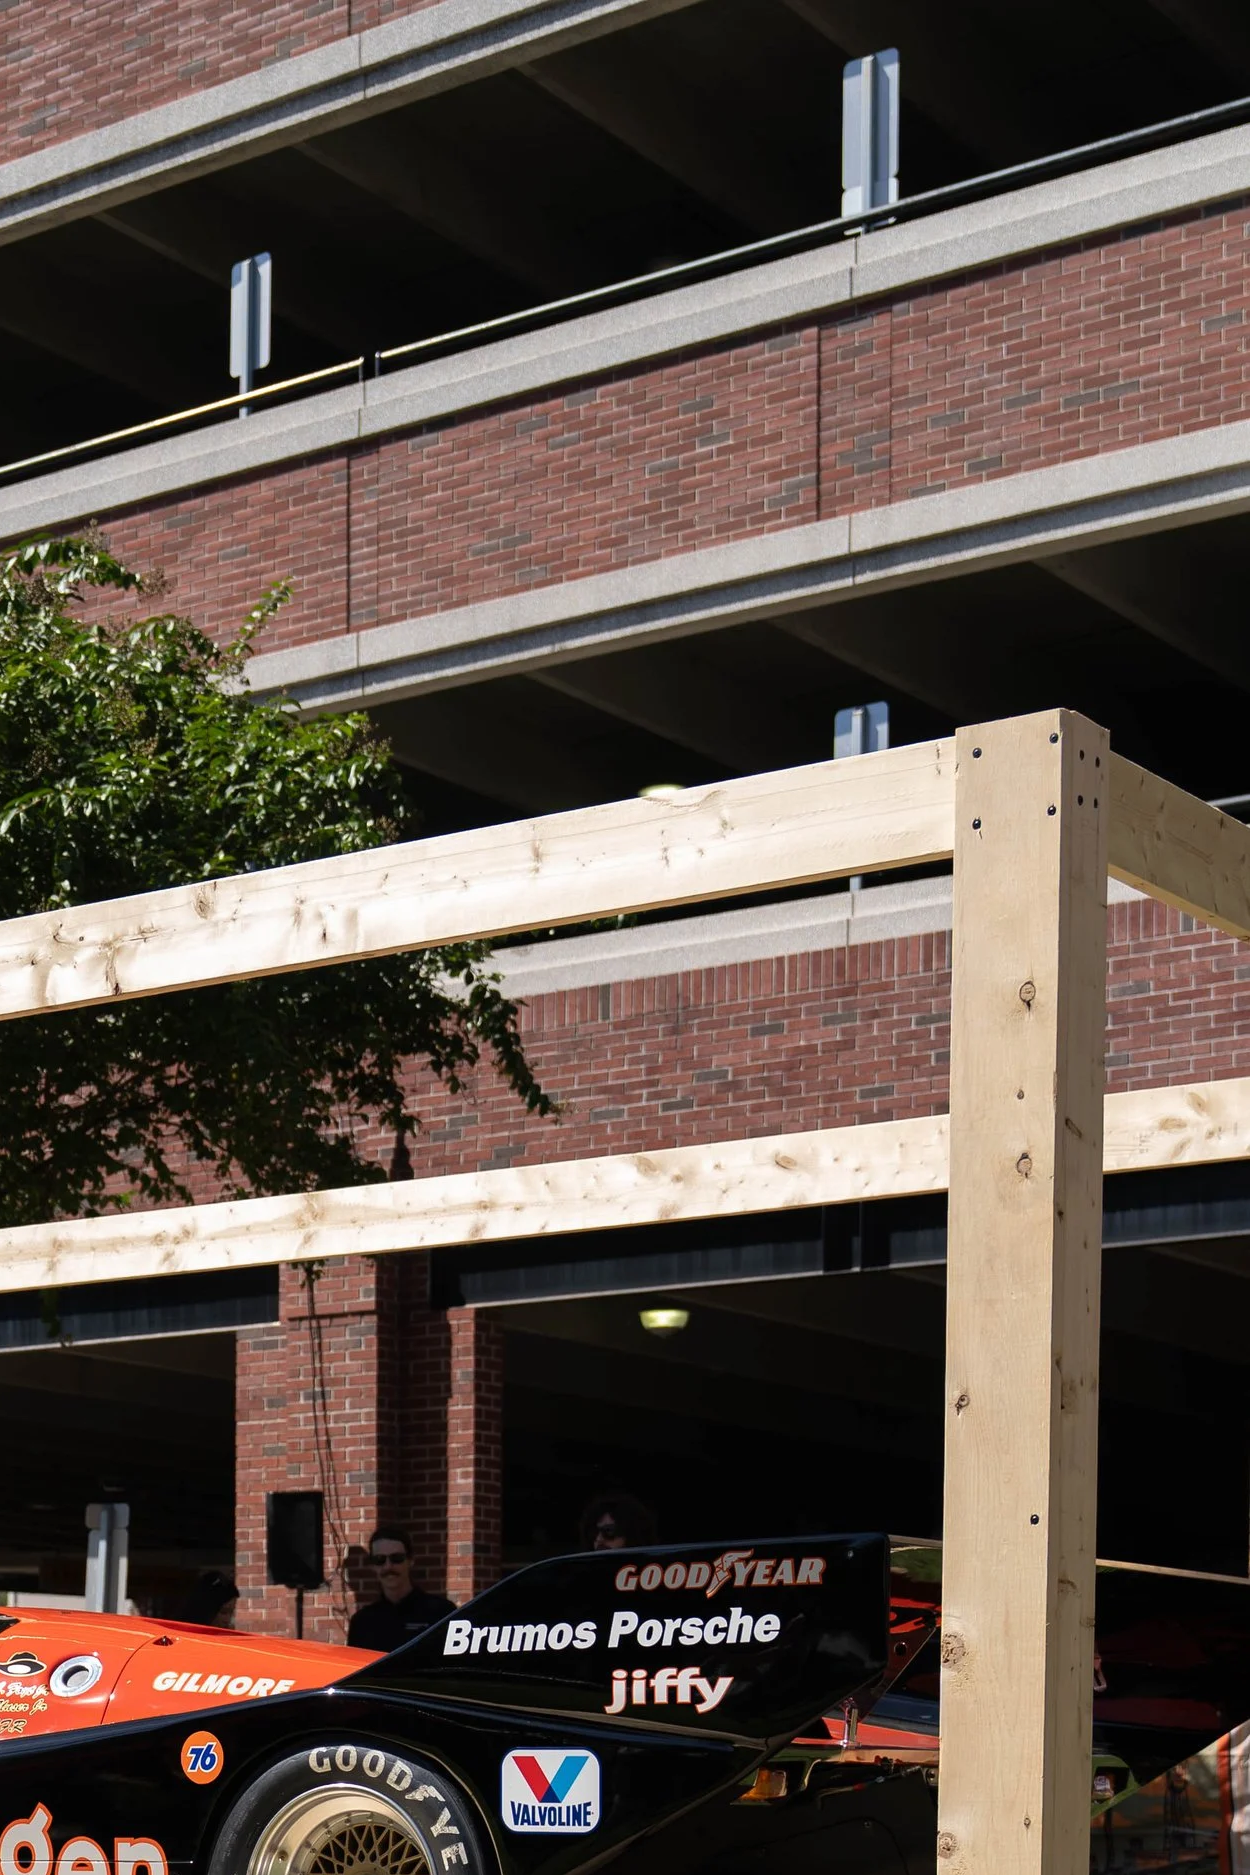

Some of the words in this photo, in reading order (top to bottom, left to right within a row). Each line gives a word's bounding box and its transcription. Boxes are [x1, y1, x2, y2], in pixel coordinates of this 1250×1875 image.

[615, 1556, 826, 1592] GOODYEAR
[443, 1618, 597, 1655] Brumos
[607, 1607, 780, 1648] Porsche
[152, 1671, 296, 1697] GILMORE
[604, 1667, 734, 1714] jiffy
[187, 1742, 218, 1772] 76
[510, 1801, 593, 1828] VALVOLINE
